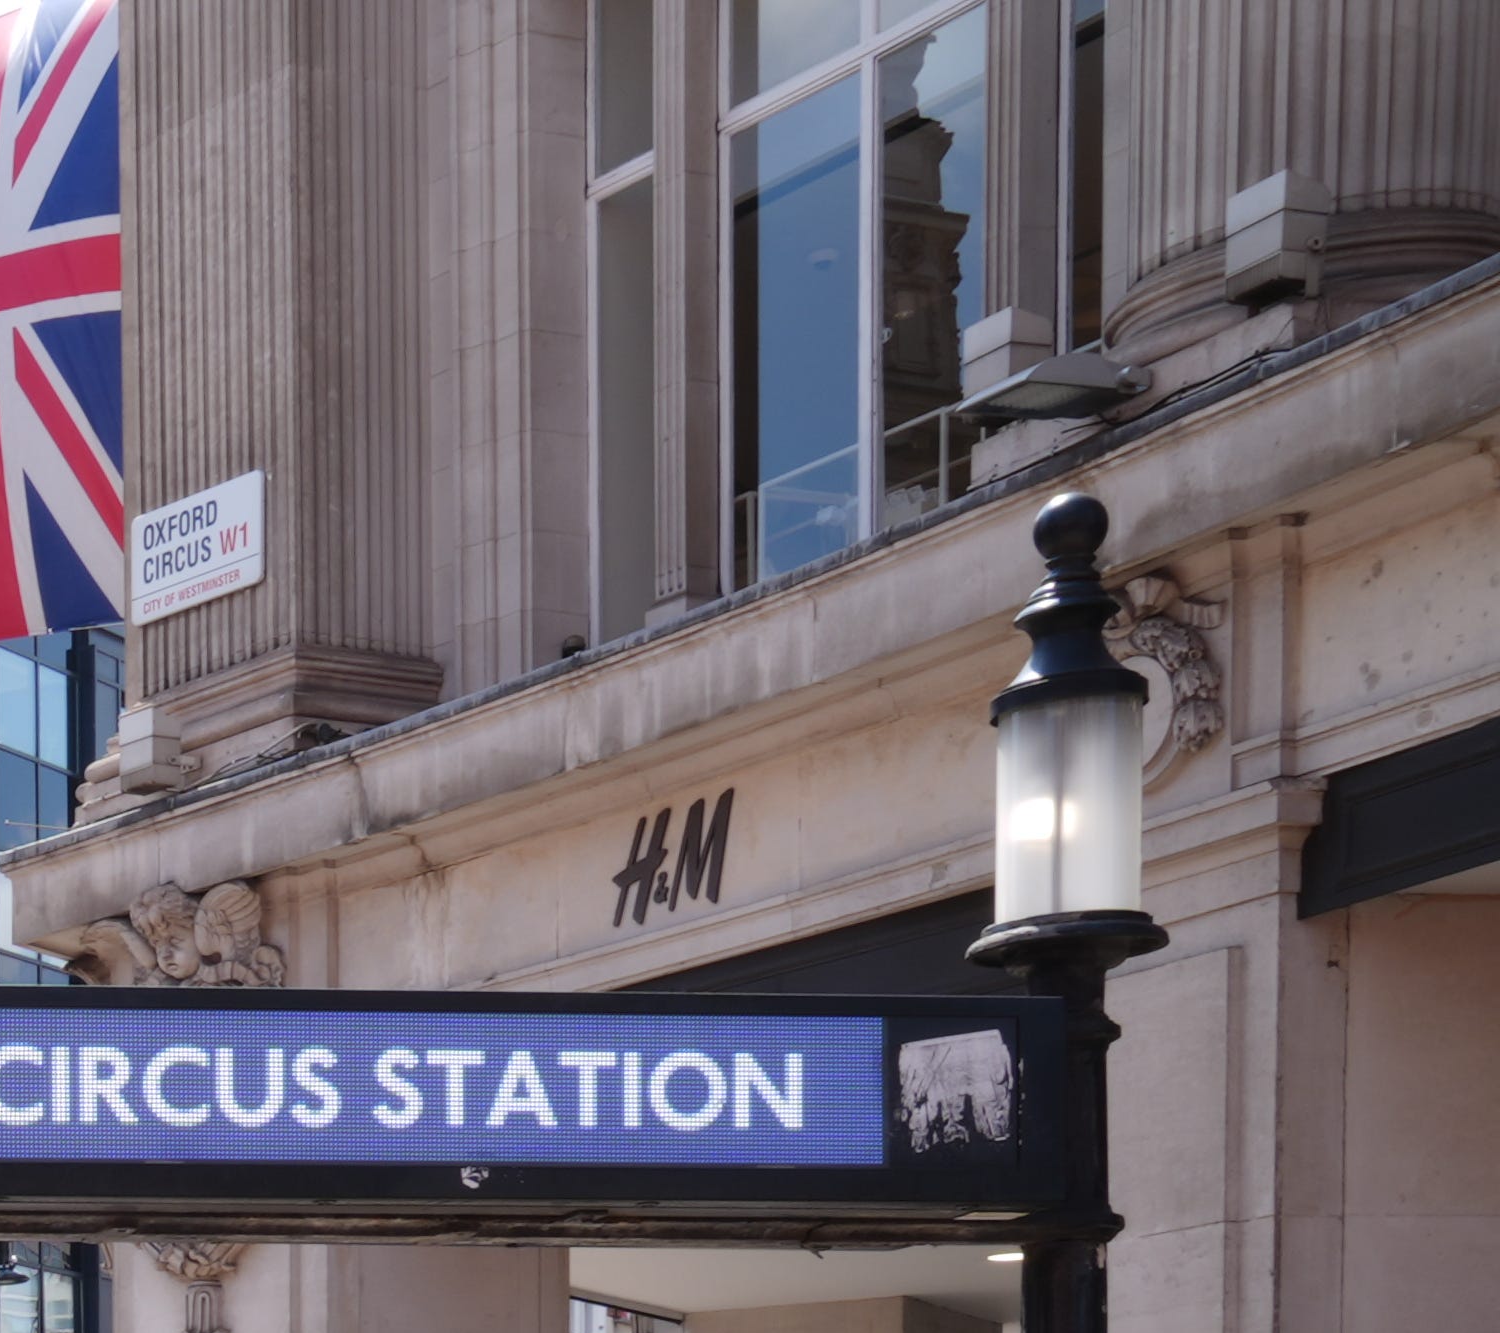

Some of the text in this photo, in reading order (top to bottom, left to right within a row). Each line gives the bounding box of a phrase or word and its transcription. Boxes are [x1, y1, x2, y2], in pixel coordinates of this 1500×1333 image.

[143, 500, 218, 550] OXFORD
[143, 521, 248, 584] CIRCUS W1
[143, 569, 241, 614] CITY OF WESTMINSTER
[612, 786, 735, 928] H&M
[374, 1048, 804, 1130] STATION
